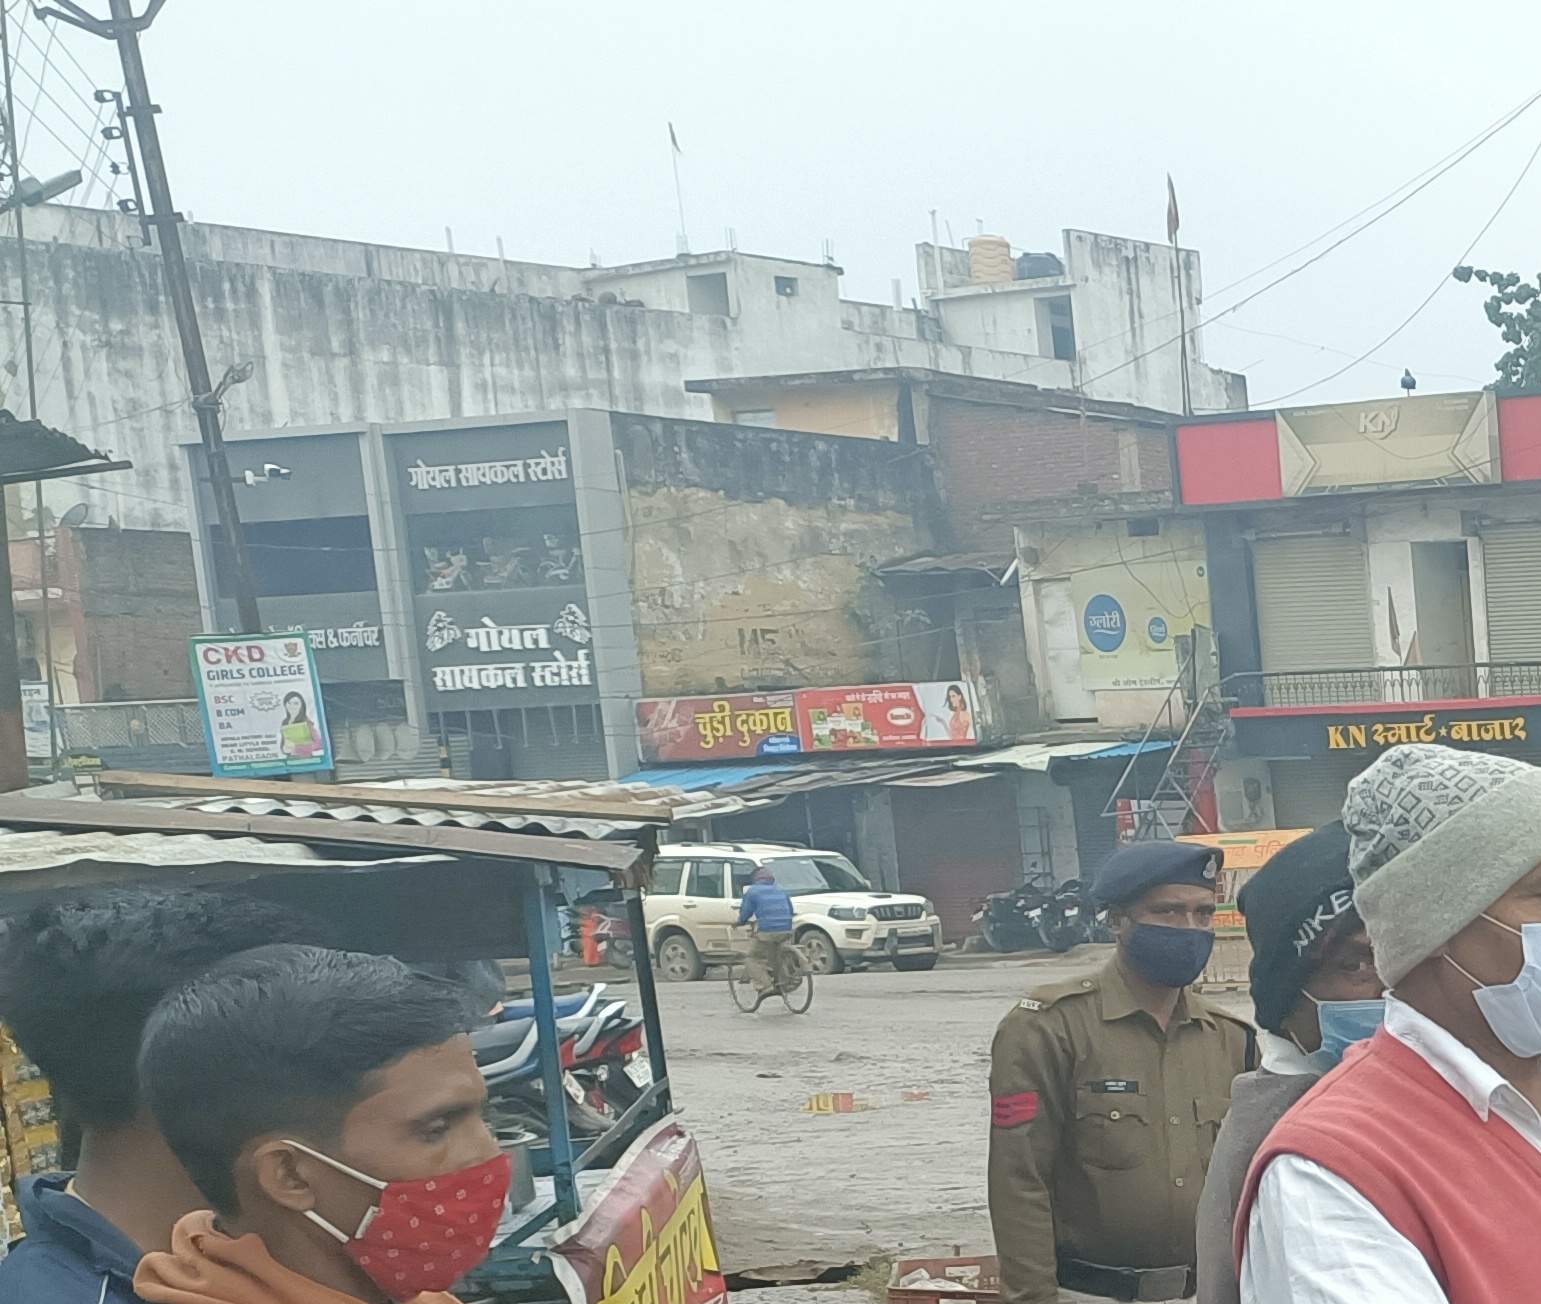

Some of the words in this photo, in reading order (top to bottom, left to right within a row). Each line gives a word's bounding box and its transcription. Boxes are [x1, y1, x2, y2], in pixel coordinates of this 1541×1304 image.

[408, 459, 455, 490] गोयल
[458, 460, 525, 486] सायकल
[527, 447, 568, 481] स्टोर्स
[464, 617, 551, 651] गोयल
[1088, 611, 1121, 629] ग्लोरी
[328, 629, 339, 648] &
[203, 645, 265, 666] CKD
[530, 649, 592, 687] स्टोर्स
[207, 667, 246, 681] GIRLS
[250, 664, 305, 679] COLLEGE
[432, 663, 527, 691] सायकल
[214, 696, 234, 704] BSC
[225, 709, 245, 717] COM
[736, 706, 793, 748] दुकान
[1327, 725, 1366, 749] KN
[1372, 714, 1438, 744] स्मार्ट
[1449, 716, 1527, 742] बाजार
[1293, 889, 1353, 957] NIKE
